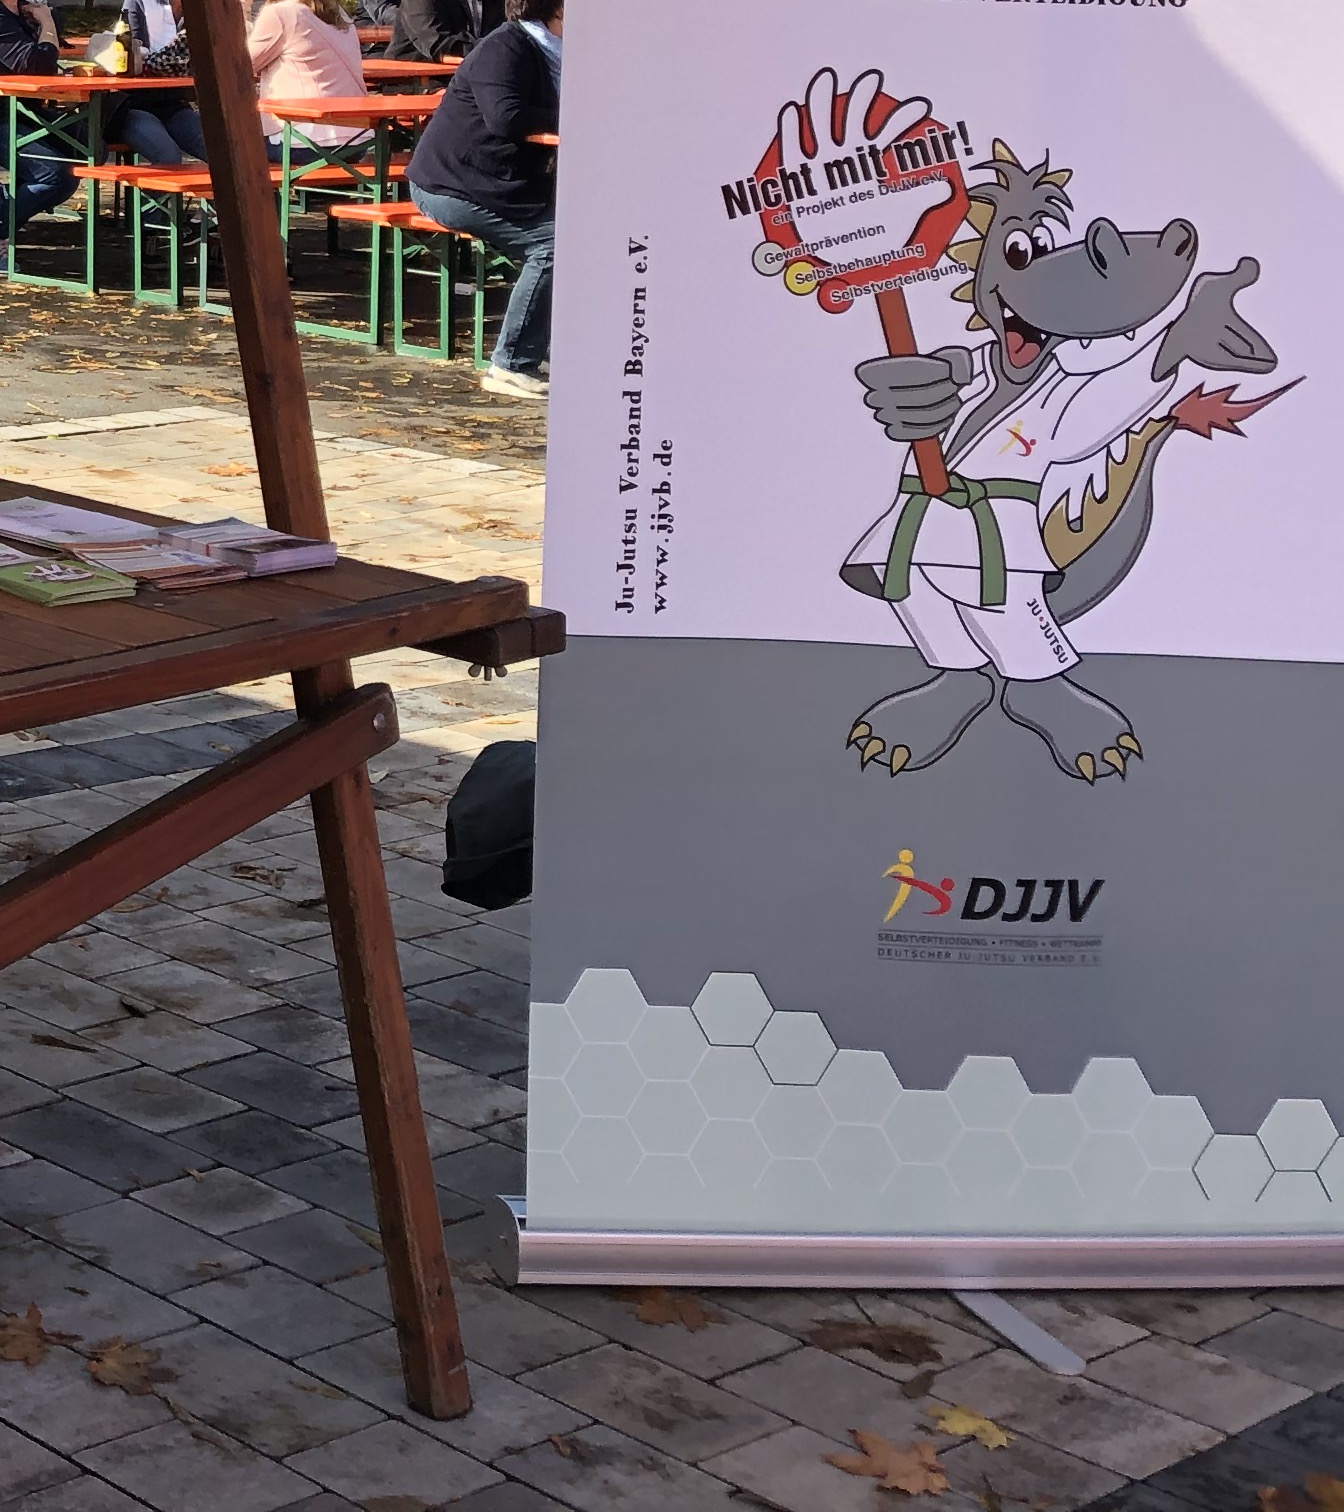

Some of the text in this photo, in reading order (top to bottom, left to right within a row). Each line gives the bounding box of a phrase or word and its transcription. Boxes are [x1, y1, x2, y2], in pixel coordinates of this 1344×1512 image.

[721, 120, 975, 220] Nicht mit mir!
[772, 210, 794, 226] ein
[796, 194, 846, 219] Projekt
[848, 187, 875, 204] des
[763, 223, 886, 265] Gewaltprävention
[794, 243, 925, 285] Selbstbehauptung
[831, 261, 968, 303] Selbstverteidigung
[615, 235, 651, 614] Ju-Jutsu Verband Bayern e.V.
[649, 438, 674, 615] www.jjvb.de
[960, 876, 1106, 923] DJJV
[877, 947, 952, 960] DEUTSCHER
